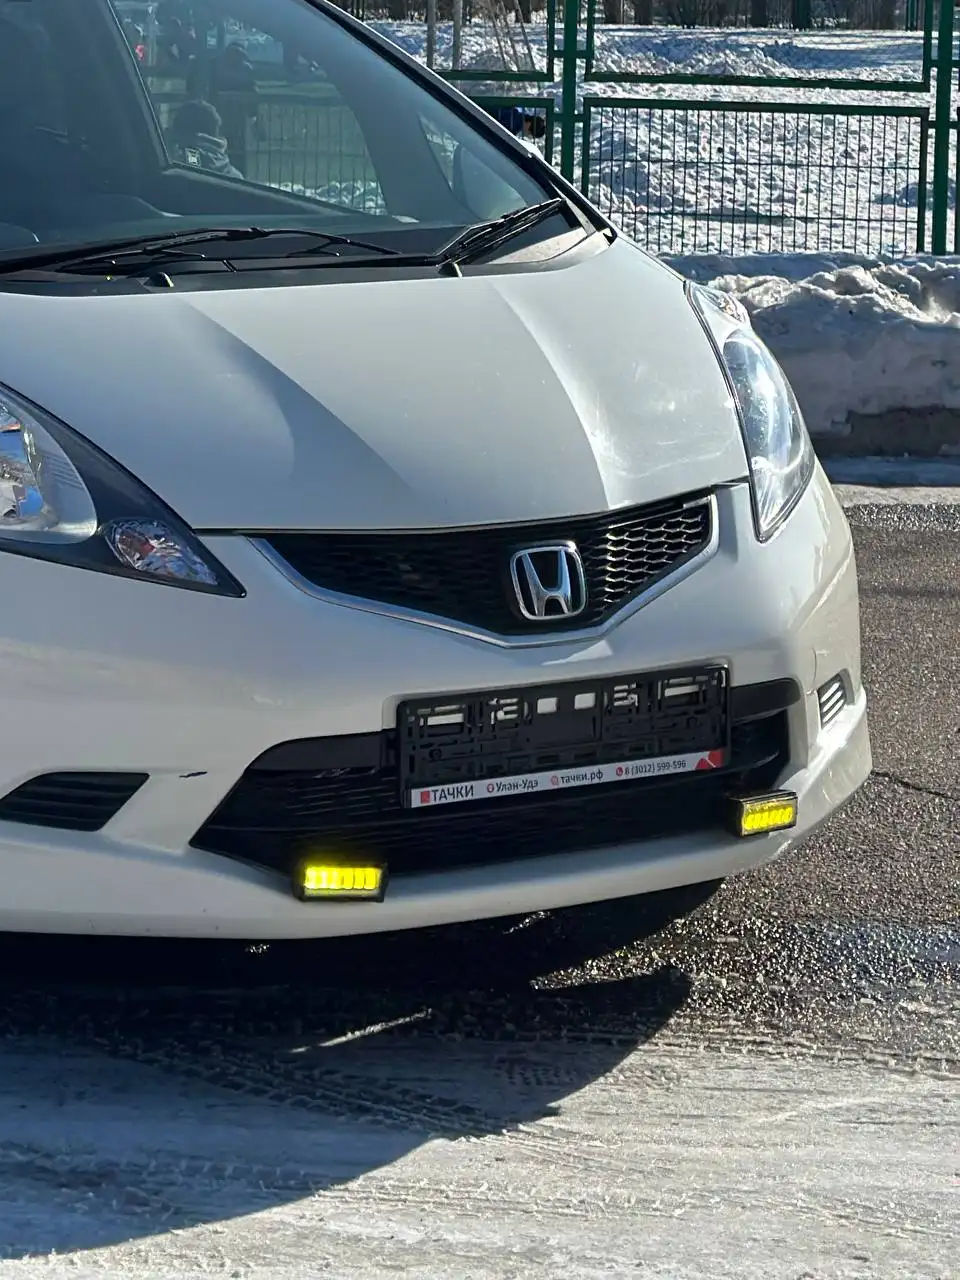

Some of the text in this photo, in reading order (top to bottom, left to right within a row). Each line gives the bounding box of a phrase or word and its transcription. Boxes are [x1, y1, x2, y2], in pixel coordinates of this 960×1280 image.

[431, 785, 474, 802] ТАЧКИ
[496, 779, 539, 792] Улан-Удэ
[560, 769, 604, 784] тачки.рф
[624, 766, 630, 776] 8
